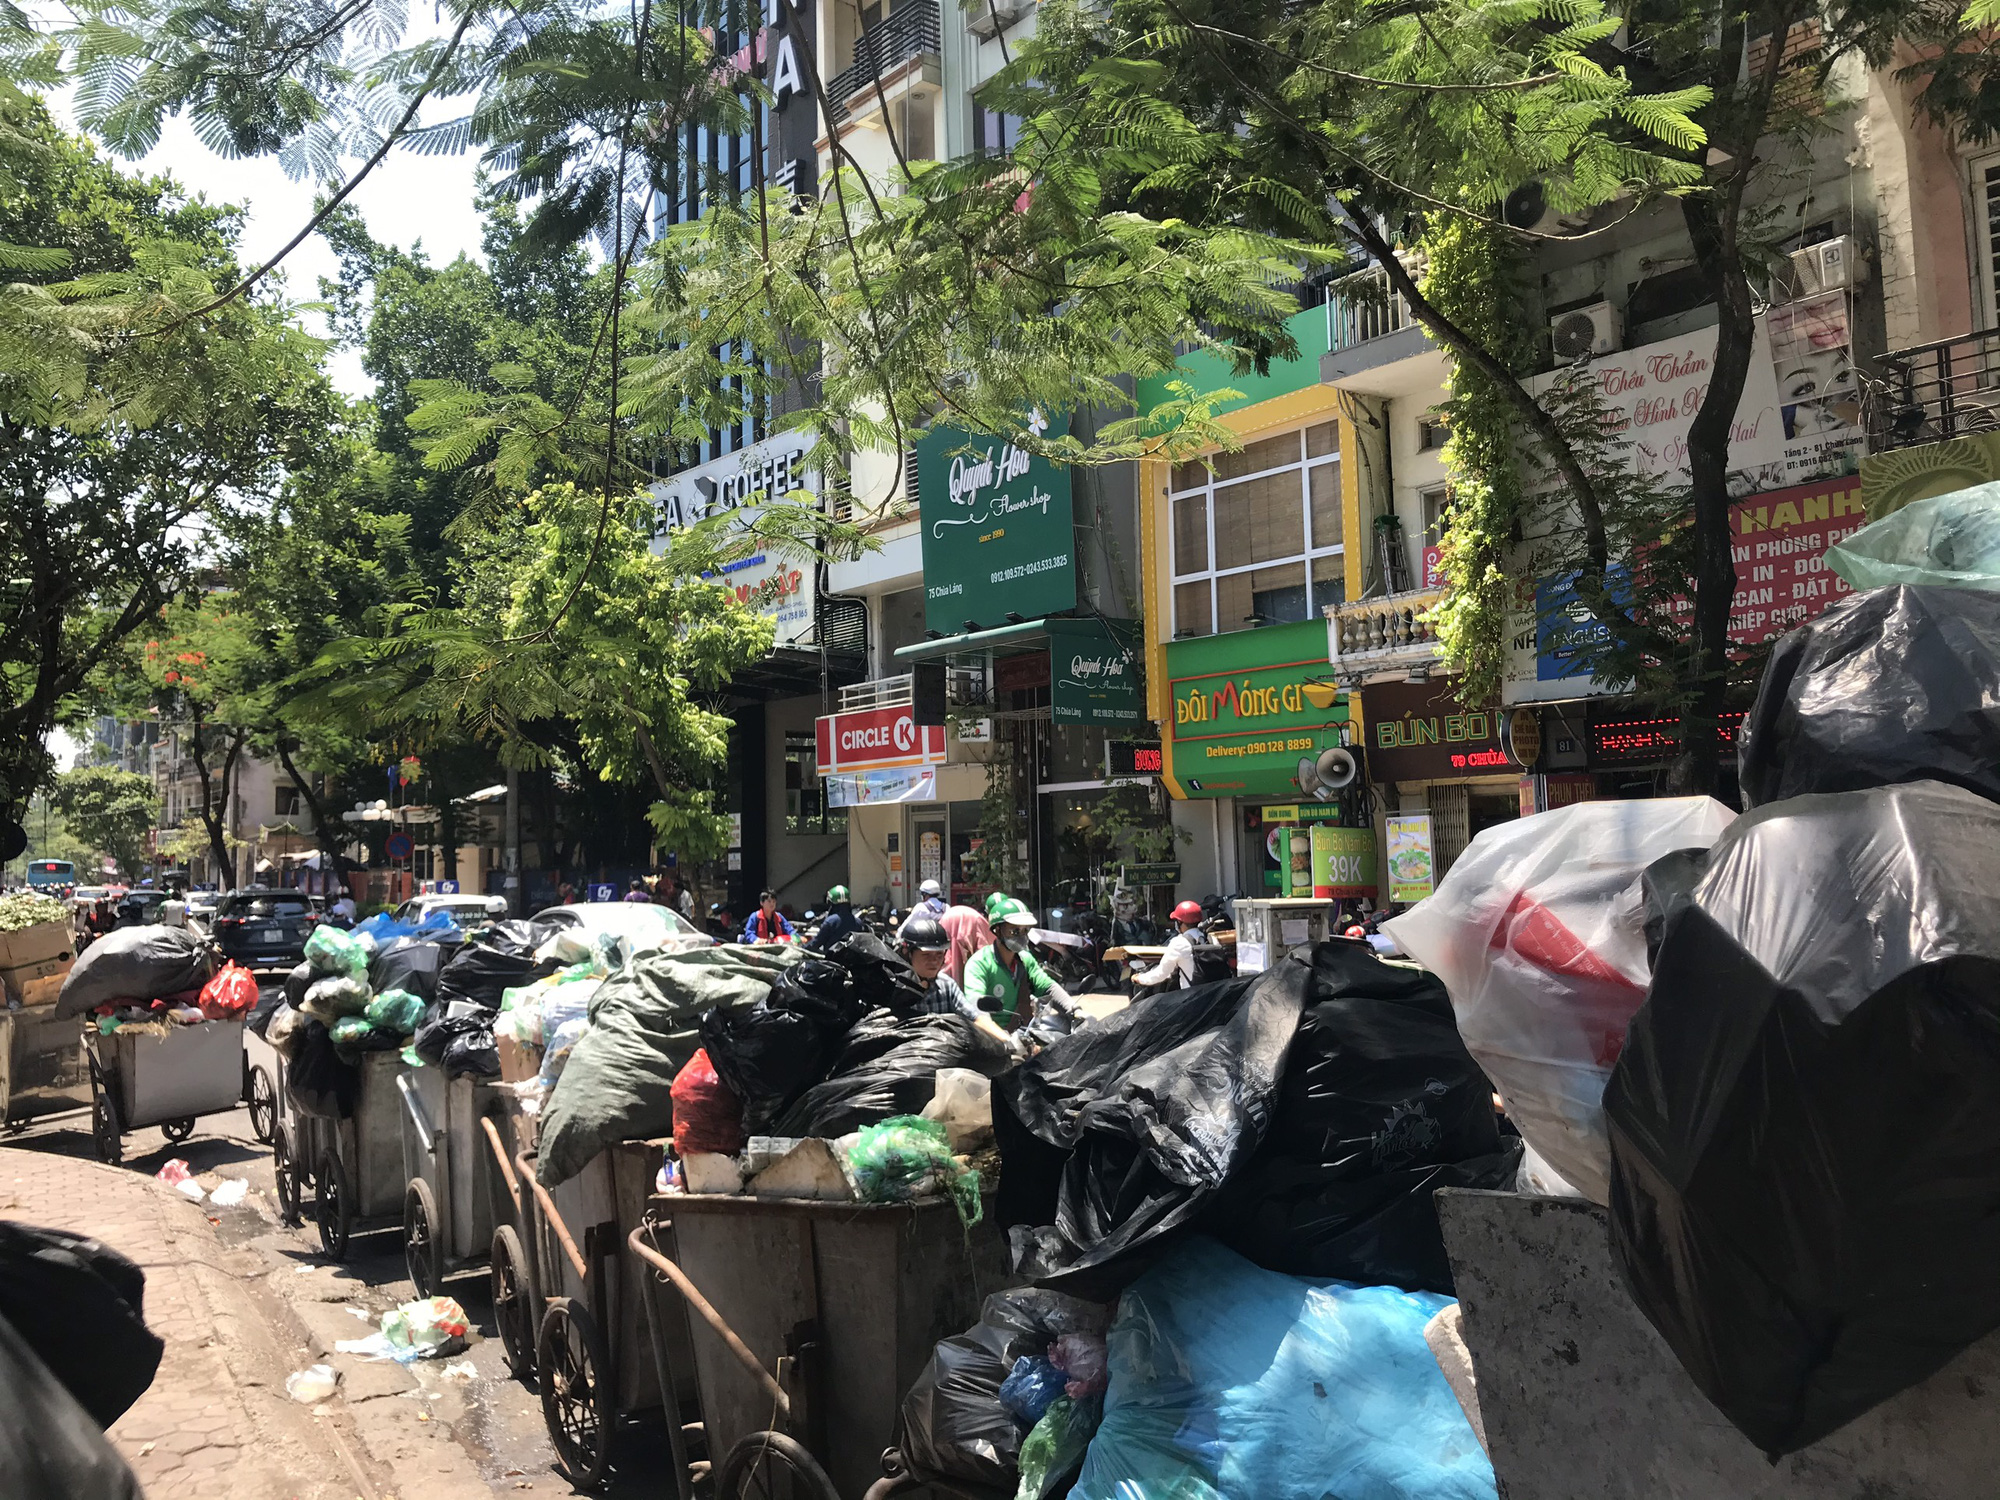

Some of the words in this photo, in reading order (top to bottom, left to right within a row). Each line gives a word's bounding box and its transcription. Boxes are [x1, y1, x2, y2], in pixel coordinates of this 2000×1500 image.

[1803, 447, 1808, 455] 2
[994, 443, 1031, 489] Hoa
[720, 449, 803, 511] COFFEE
[990, 494, 1028, 517] Flower
[1029, 484, 1052, 515] shop
[1740, 487, 1862, 534] HẠNH
[1756, 532, 1822, 560] PHÒNG
[1753, 564, 1774, 582] IN
[928, 588, 936, 600] 75
[1792, 576, 1829, 601] ĐẶT
[1102, 657, 1124, 676] Hoa
[1177, 689, 1209, 723] ĐÔI
[841, 726, 890, 751] CIRCLE
[1376, 709, 1439, 749] BÚN
[1206, 744, 1246, 758] Delivery:
[1247, 742, 1266, 754] 090
[1268, 740, 1284, 752] 128
[1287, 738, 1312, 751] 8899
[1451, 754, 1466, 768] 79
[1468, 748, 1508, 767] CHÙA
[1559, 741, 1571, 752] 81
[1549, 782, 1572, 803] PHUN
[1328, 854, 1364, 883] 39K
[597, 885, 612, 901] G7
